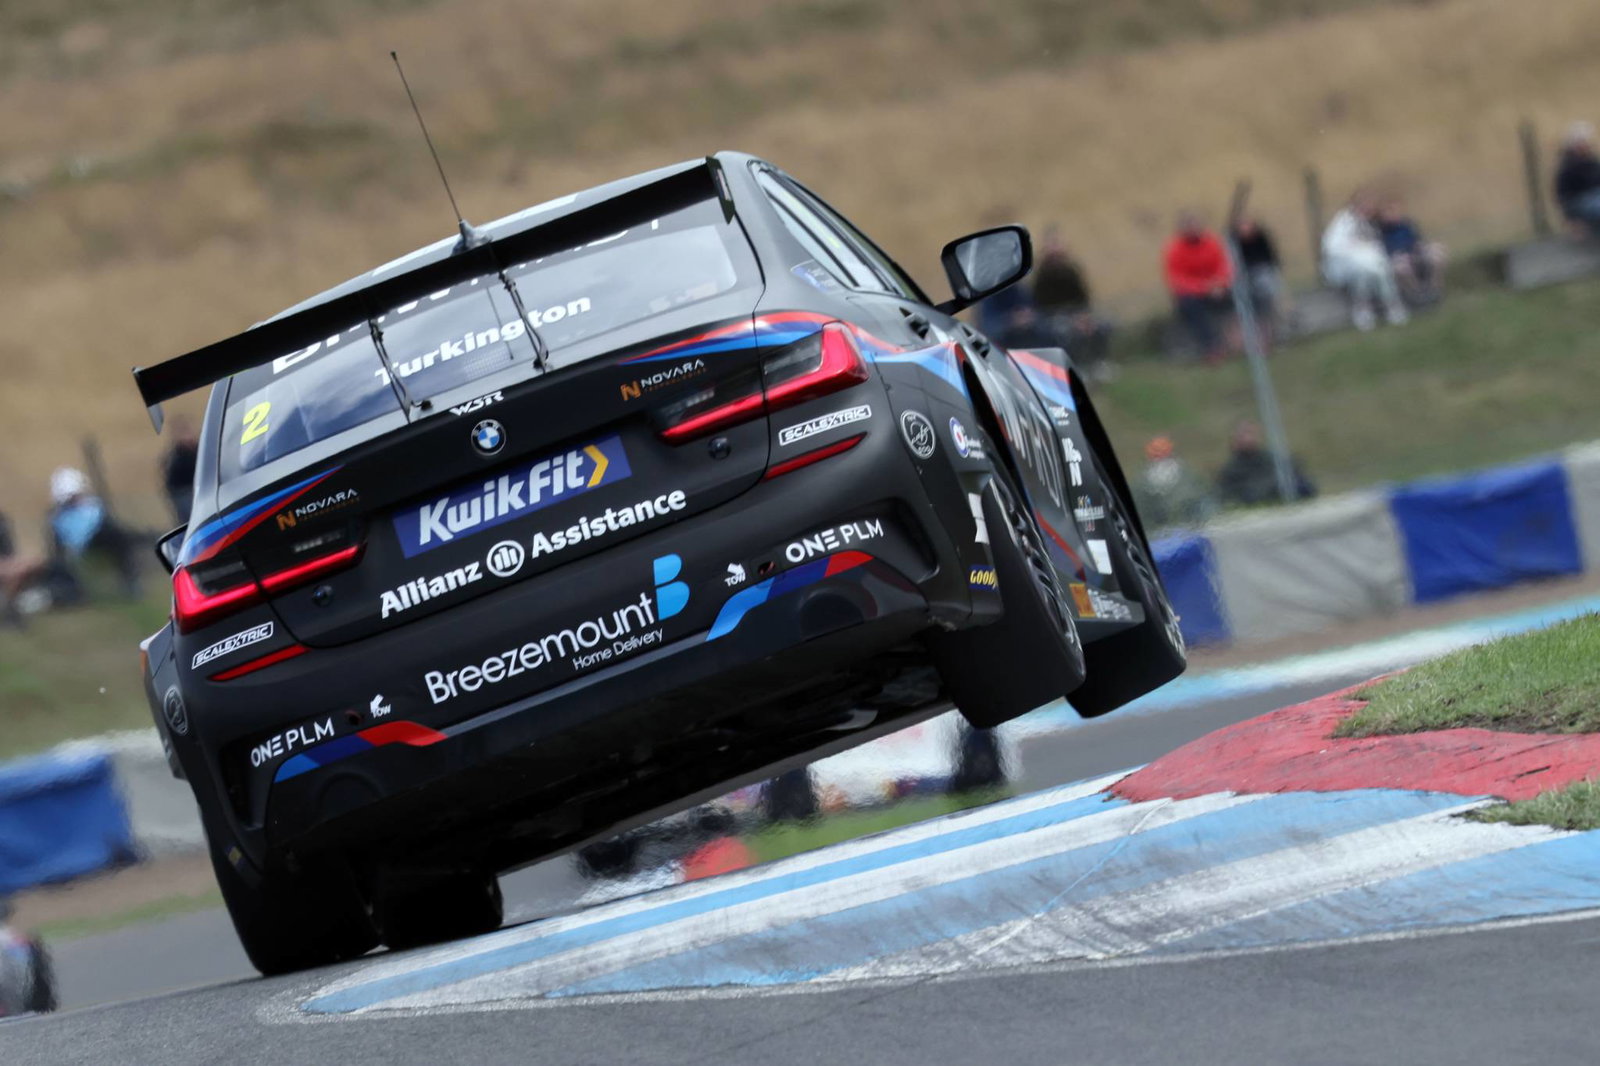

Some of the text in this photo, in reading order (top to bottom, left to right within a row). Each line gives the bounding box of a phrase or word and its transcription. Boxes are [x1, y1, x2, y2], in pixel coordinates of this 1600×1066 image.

[375, 297, 591, 386] Turkington
[641, 359, 705, 388] NOVARA
[240, 402, 271, 445] 2
[449, 388, 504, 416] WSR
[784, 408, 867, 441] SCALEXTRIC
[295, 488, 359, 517] NOVARA
[379, 490, 687, 619] Allianz Assistance
[785, 517, 884, 563] ONE PLM
[195, 625, 269, 665] SCALEXTRIC
[424, 591, 655, 705] Breezemount
[572, 627, 664, 671] Home Delivery
[251, 717, 336, 768] ONE PLM
